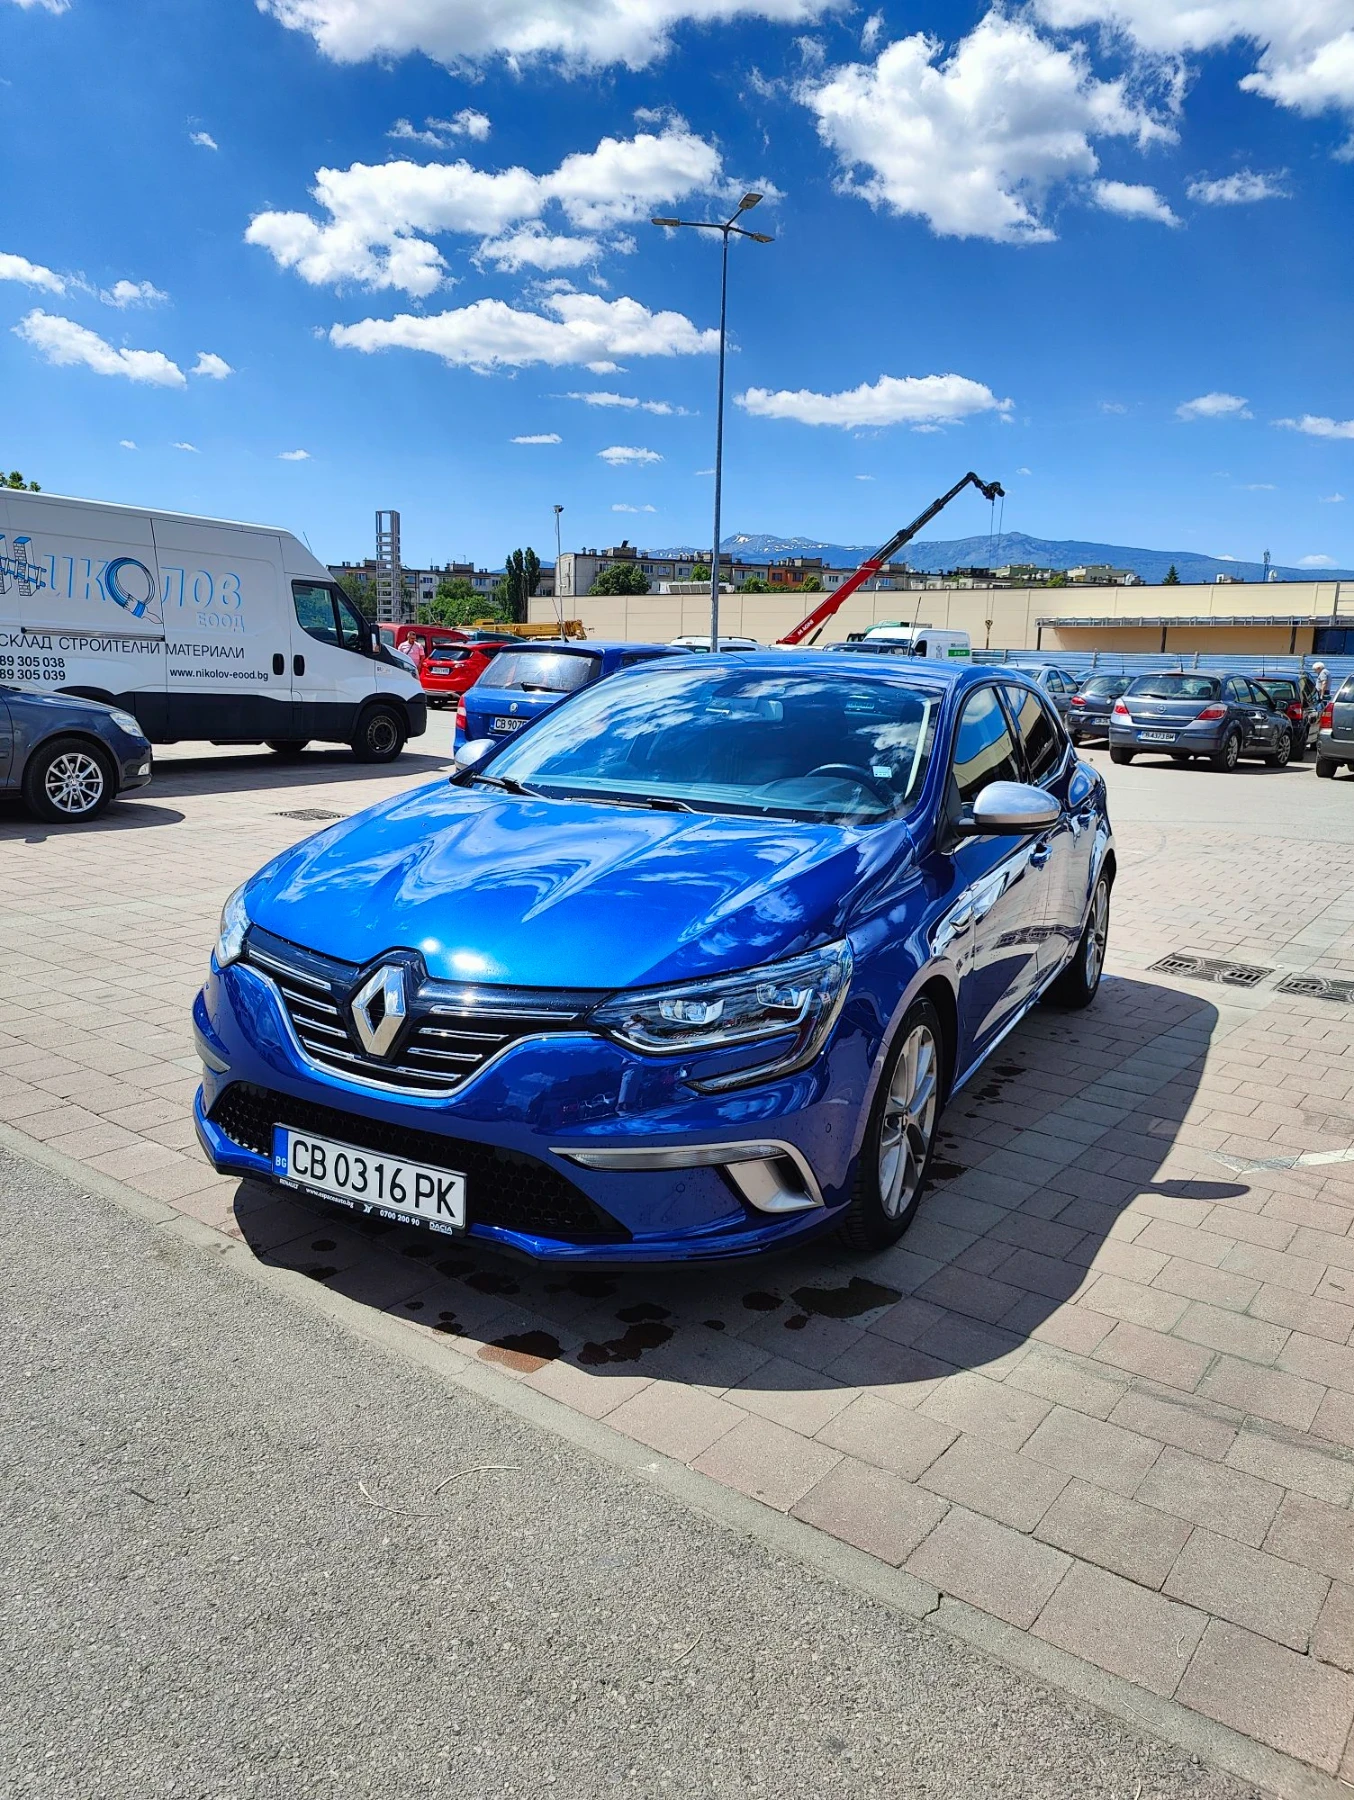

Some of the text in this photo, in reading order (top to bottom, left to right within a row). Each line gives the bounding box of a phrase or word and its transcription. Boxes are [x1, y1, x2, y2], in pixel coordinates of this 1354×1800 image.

[197, 611, 245, 633] ЕООД
[0, 633, 245, 659] СКЛАД СТРОИТЕЛНИ МАТЕРИАЛИ
[17, 655, 40, 667] 305
[42, 656, 65, 668] 038
[17, 668, 40, 680] 305
[42, 669, 66, 681] 039
[169, 668, 269, 682] www.nikolov-eood.bg
[495, 718, 506, 729] CB
[275, 1155, 287, 1168] BG
[292, 1139, 456, 1218] CB 0316 PK
[305, 1187, 355, 1209] www.espaceauto.bg
[379, 1209, 420, 1227] 0700 200 90
[429, 1221, 453, 1234] DACIA
